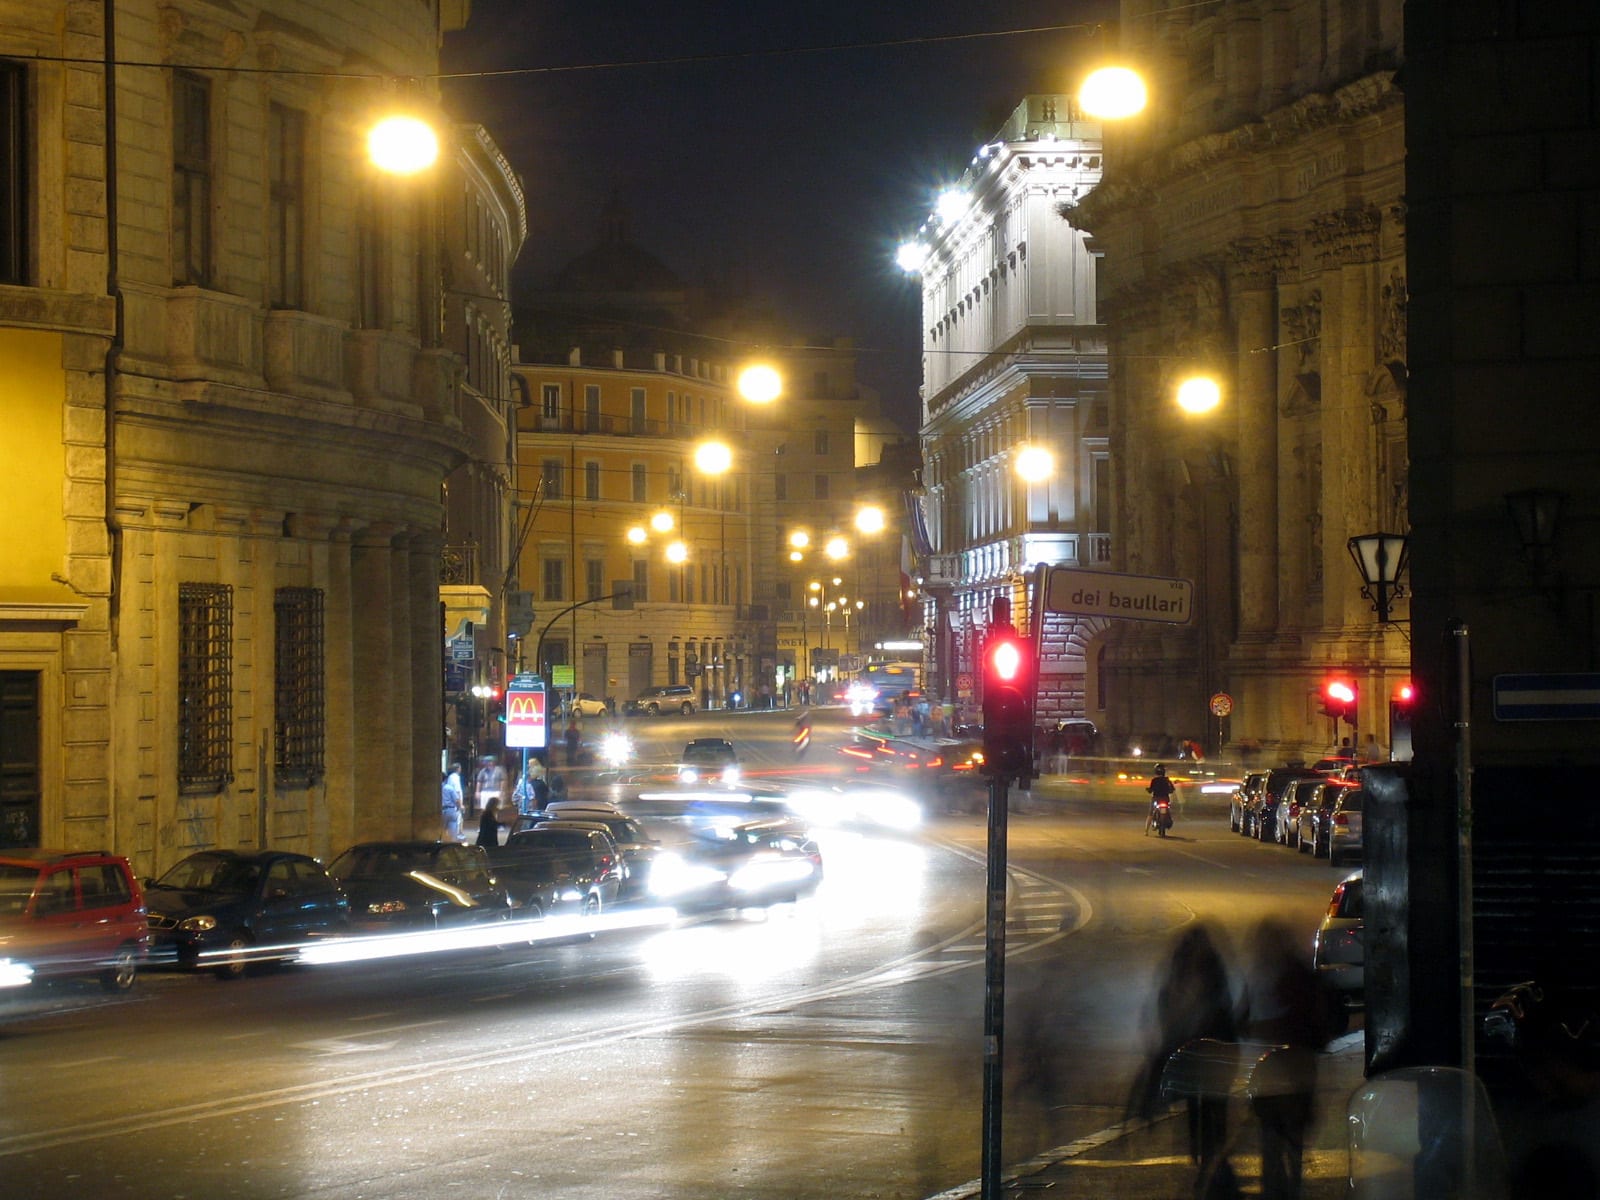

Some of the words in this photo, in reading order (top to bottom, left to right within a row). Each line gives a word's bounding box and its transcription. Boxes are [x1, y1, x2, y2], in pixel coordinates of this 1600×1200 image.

[1169, 581, 1184, 590] via
[1071, 589, 1100, 606] dei
[1109, 591, 1183, 613] baullari
